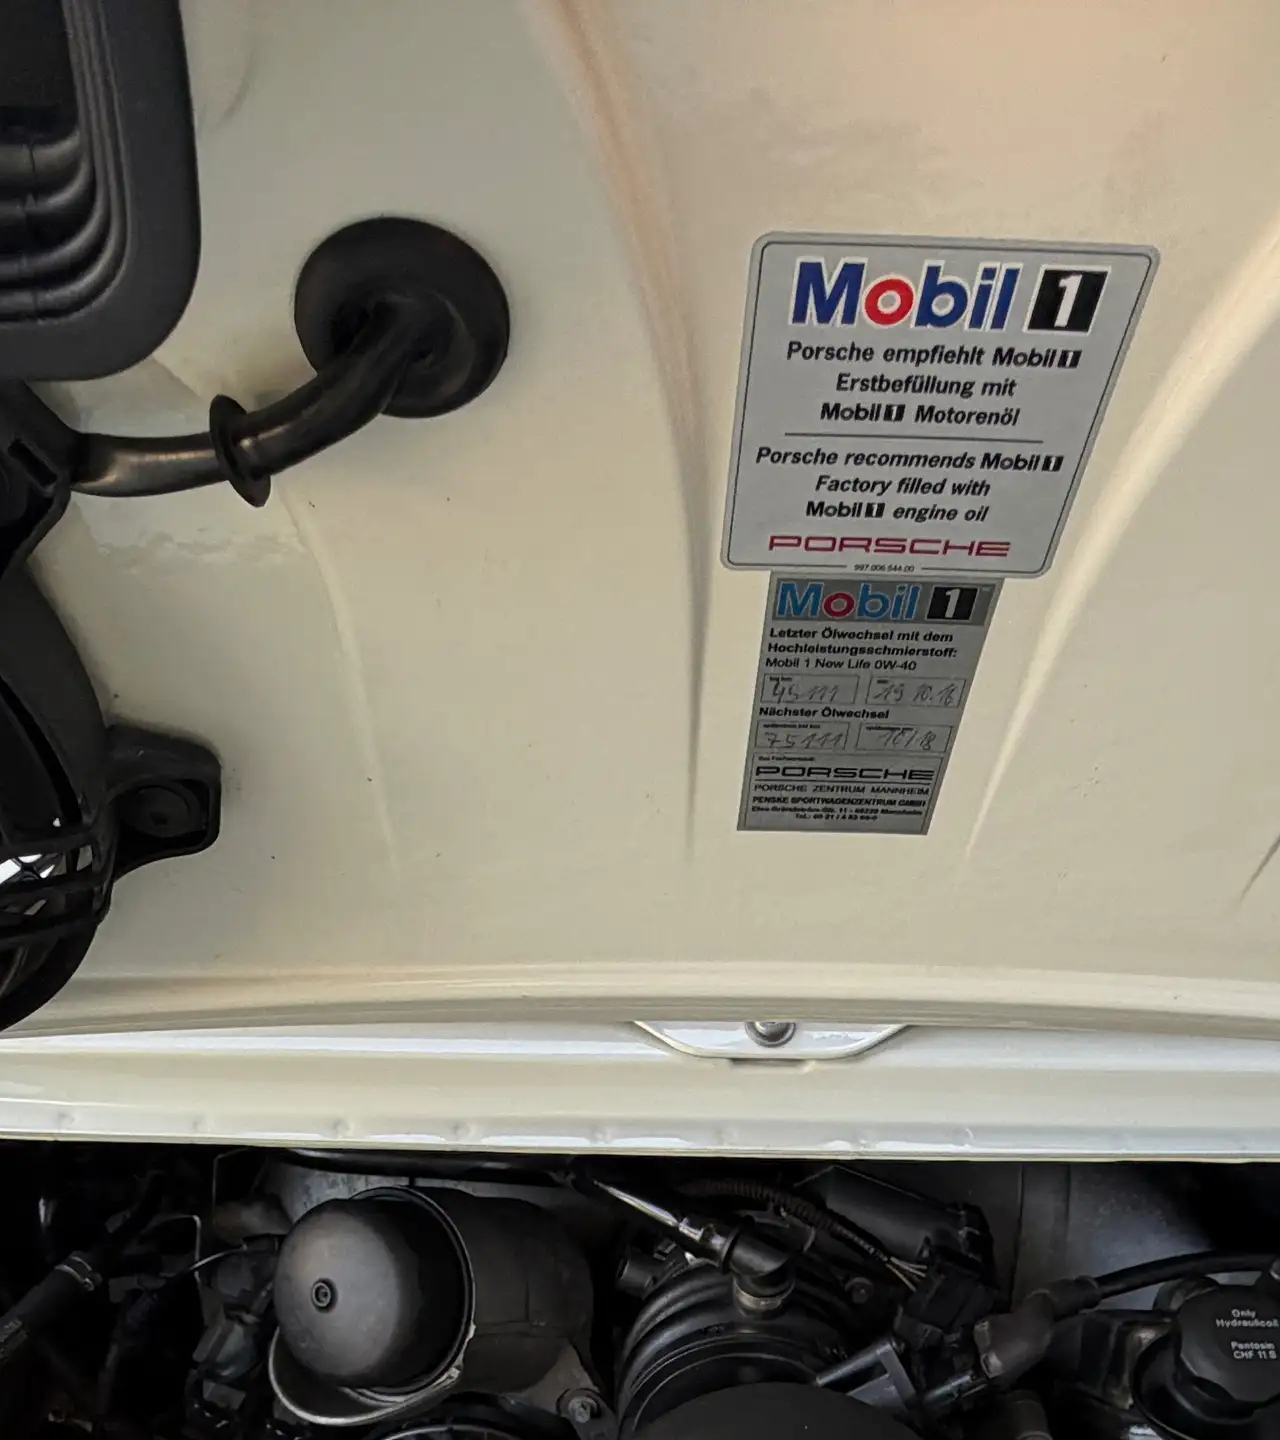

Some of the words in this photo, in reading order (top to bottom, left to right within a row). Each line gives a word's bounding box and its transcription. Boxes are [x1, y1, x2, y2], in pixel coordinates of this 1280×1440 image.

[790, 259, 1022, 331] Mobil
[787, 341, 874, 362] Porsche
[883, 346, 984, 366] empfiehlt
[836, 374, 975, 398] Erstbefüllung
[981, 379, 1017, 397] mit
[915, 405, 1020, 426] Motorenöl
[756, 447, 838, 466] Porsche
[844, 451, 975, 470] recommends
[815, 475, 892, 496] Factory
[896, 477, 945, 495] filled
[951, 479, 990, 496] with
[892, 505, 959, 522] engine
[965, 506, 989, 522] oil
[768, 535, 1012, 557] PORSCHE
[776, 580, 921, 618] Mobil
[769, 627, 818, 639] Letzter
[821, 626, 894, 640] Ölwechsel
[897, 630, 920, 641] mit
[923, 631, 954, 642] dem
[765, 657, 800, 668] Mobil
[815, 658, 844, 668] New
[848, 659, 871, 669] Life
[874, 660, 917, 671] 0W-40
[759, 706, 818, 718] Nächster
[821, 705, 890, 719] Ölwechsel
[755, 766, 935, 781] PORSCHE
[754, 784, 808, 793] PORSCHE
[812, 785, 866, 793] ZENTRUM
[870, 786, 930, 795] MANNHEIM
[1231, 1308, 1257, 1319] Only
